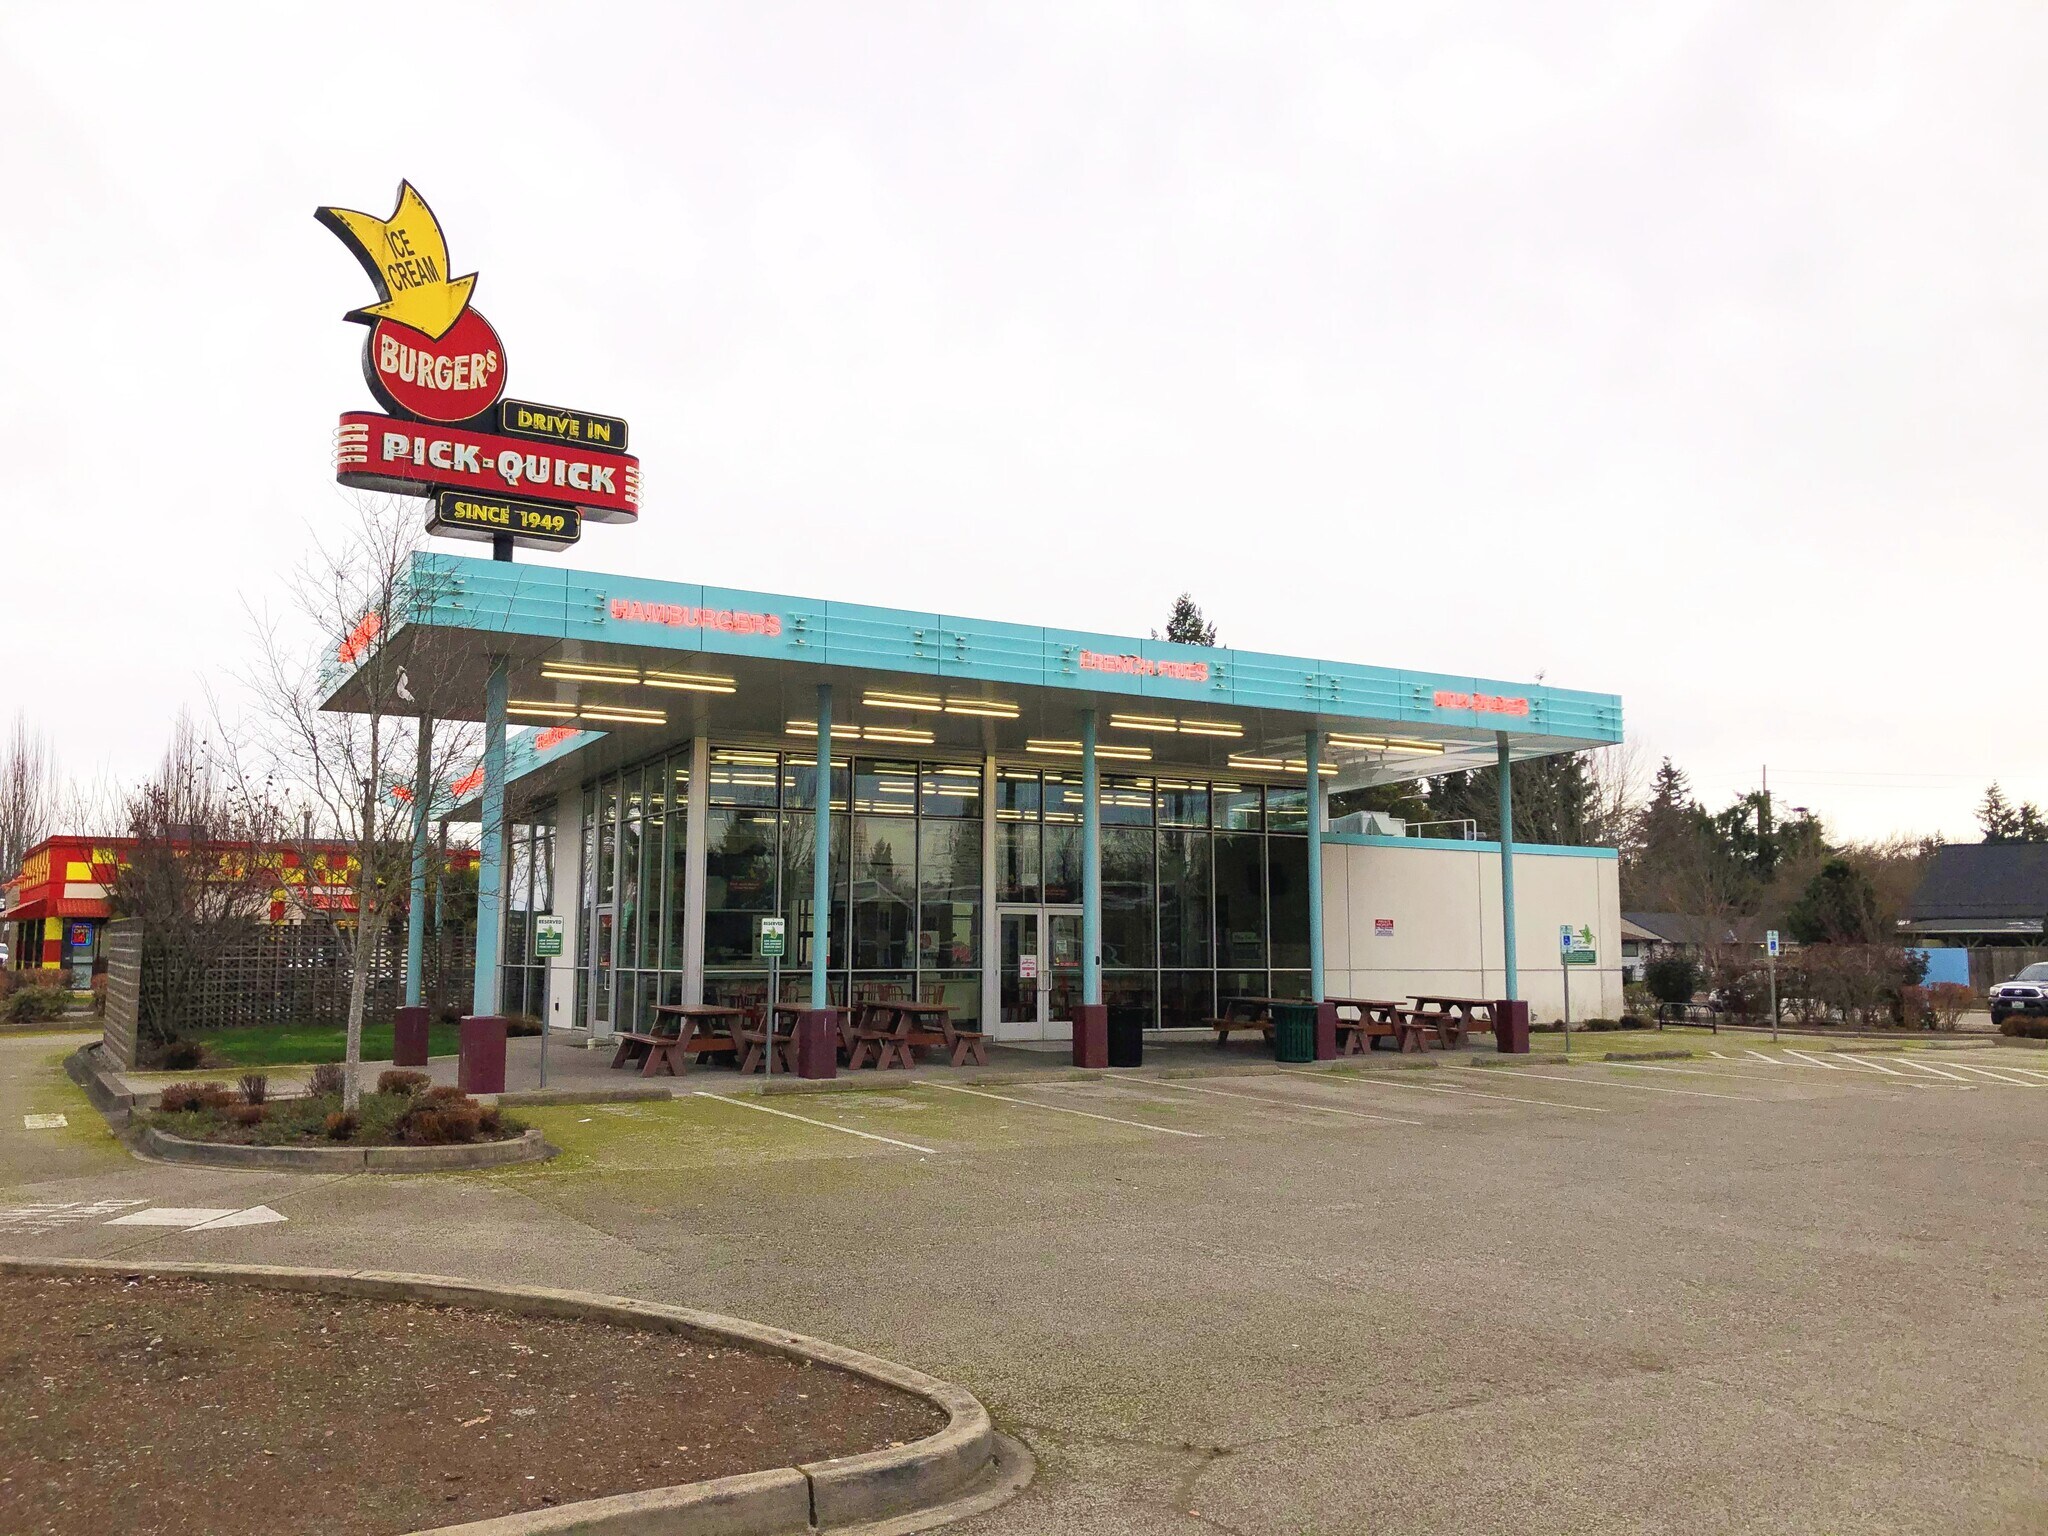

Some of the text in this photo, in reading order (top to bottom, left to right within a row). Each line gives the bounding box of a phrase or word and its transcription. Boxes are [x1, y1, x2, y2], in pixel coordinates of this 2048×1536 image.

[384, 228, 415, 260] ICE
[387, 254, 441, 292] CREAM
[517, 407, 611, 442] DRIVE IN
[383, 431, 617, 495] PICK-QUICK
[454, 501, 565, 534] SINCE 1949
[610, 598, 782, 637] HAMBURGERS
[1157, 660, 1209, 682] FRIES
